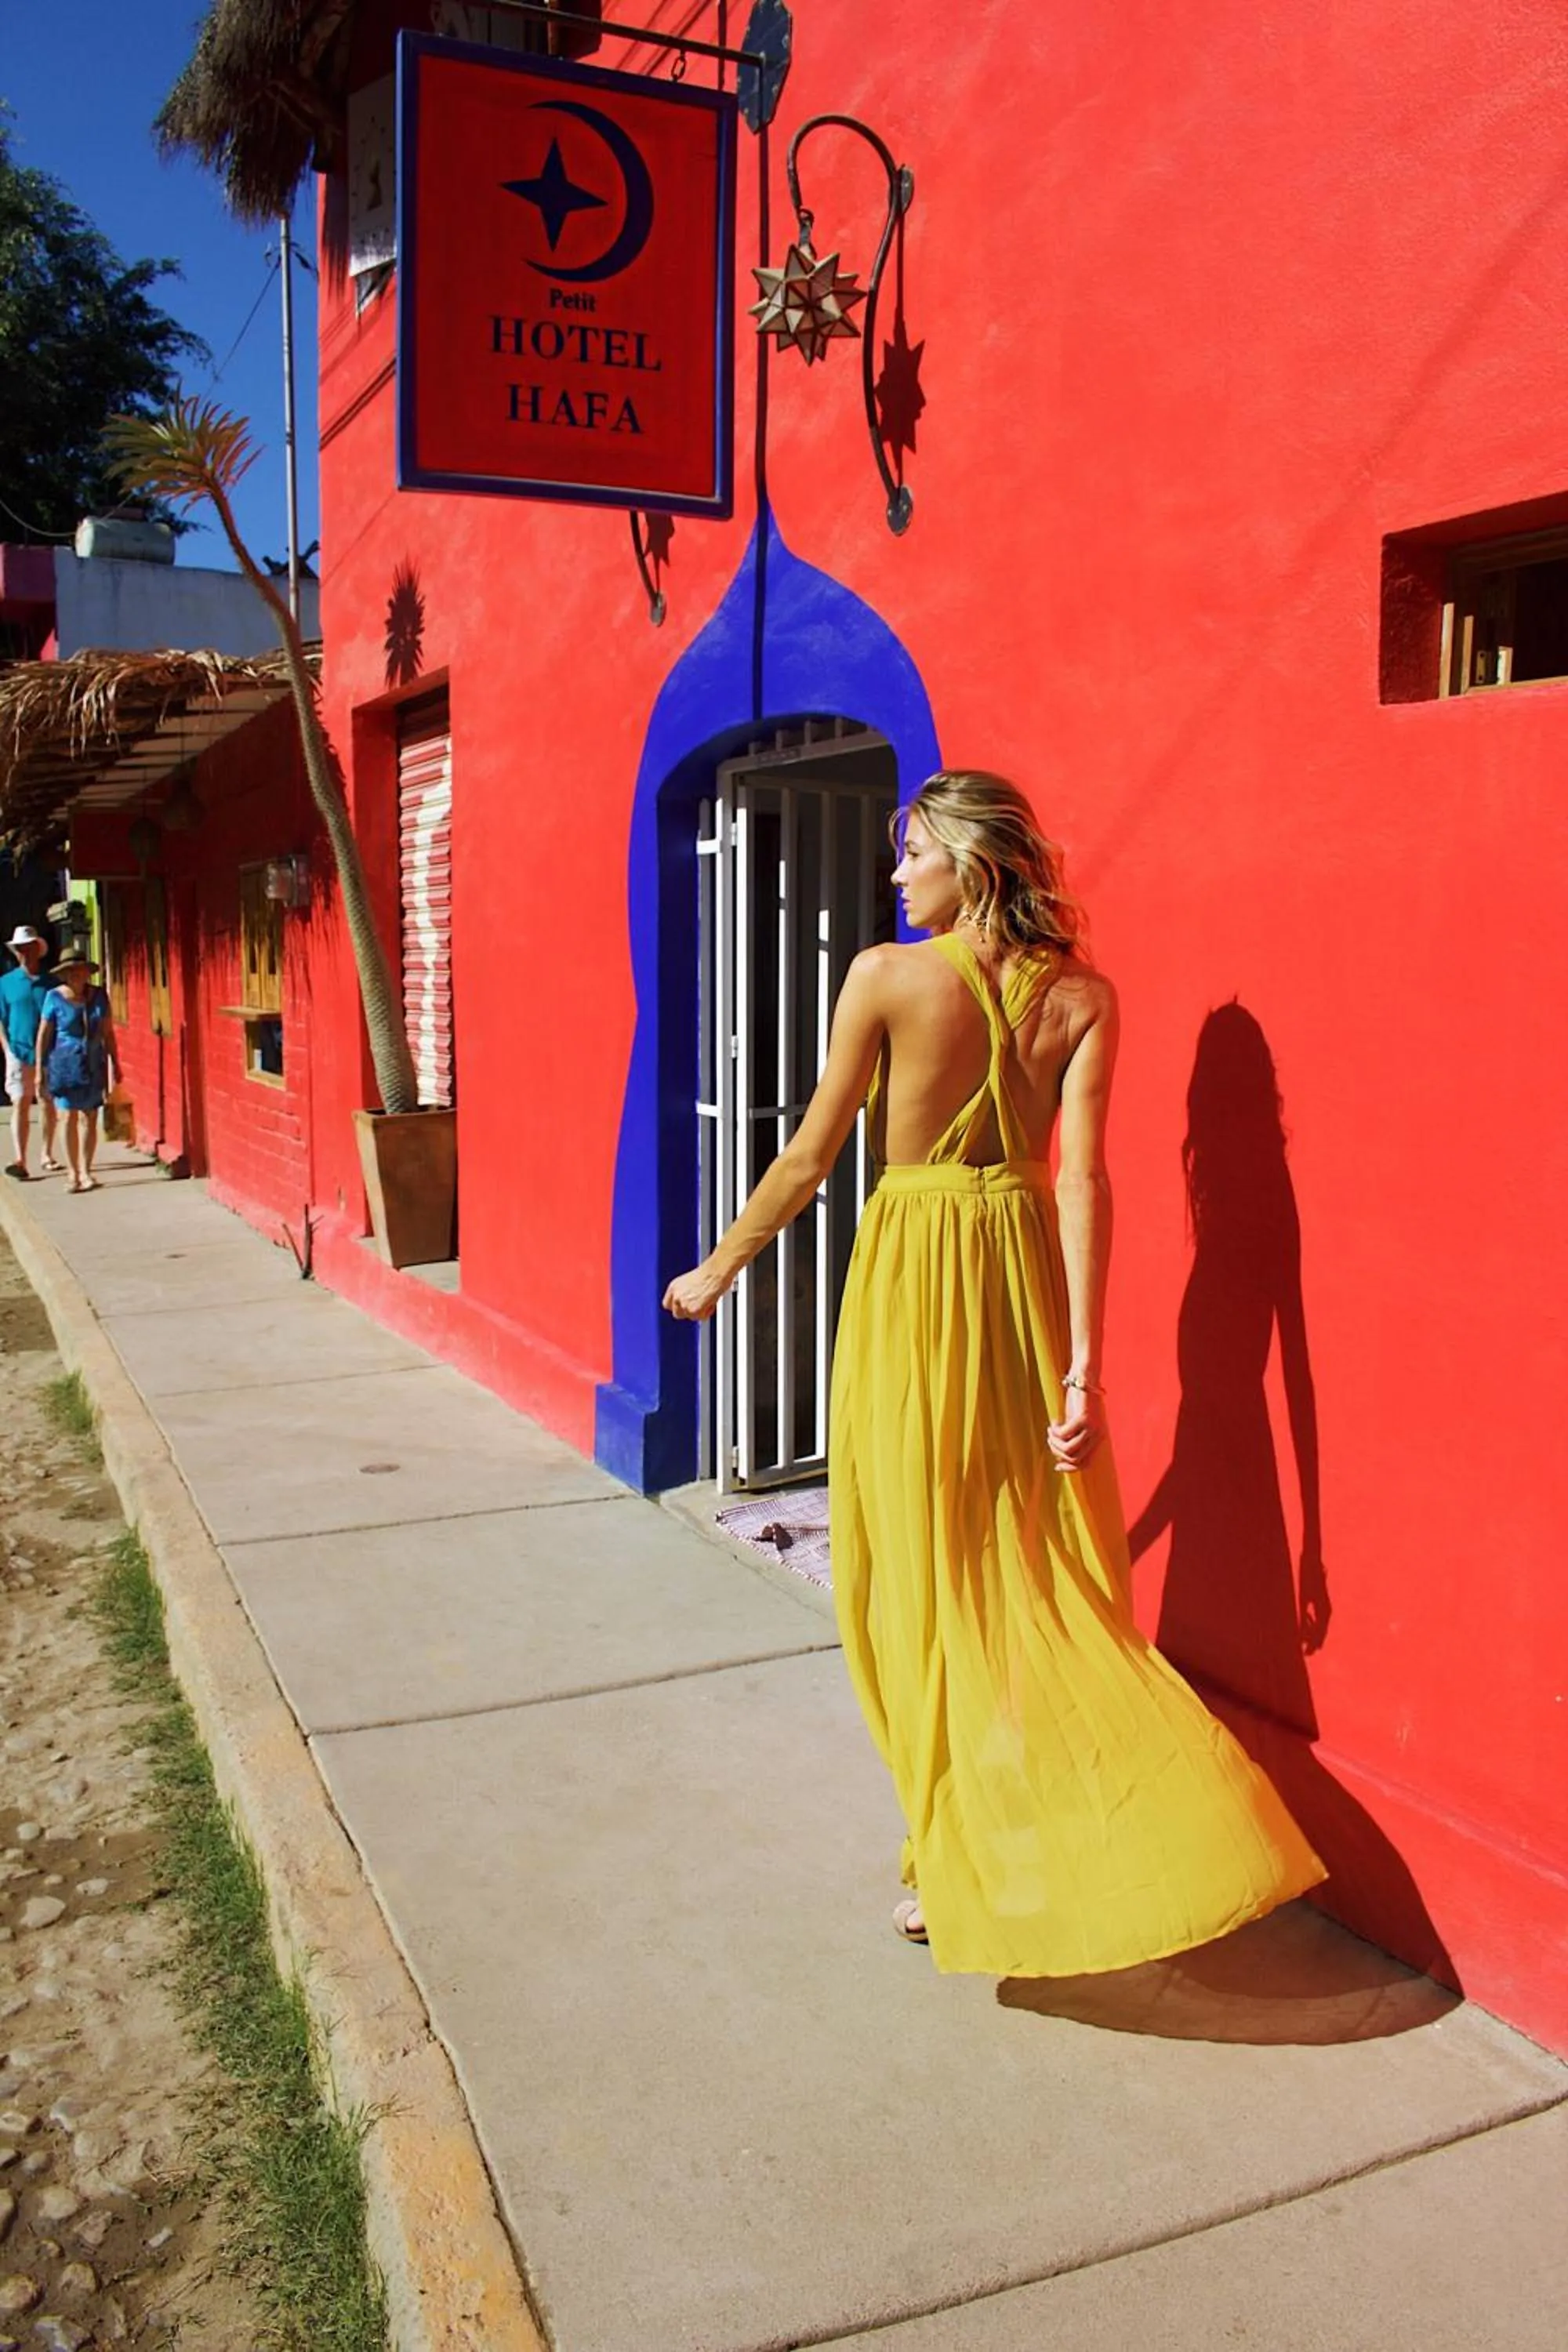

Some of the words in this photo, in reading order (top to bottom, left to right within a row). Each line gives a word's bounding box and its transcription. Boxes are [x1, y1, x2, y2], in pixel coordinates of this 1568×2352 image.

[550, 288, 597, 312] Petit
[489, 314, 662, 372] HOTEL
[506, 383, 643, 434] HAFA
